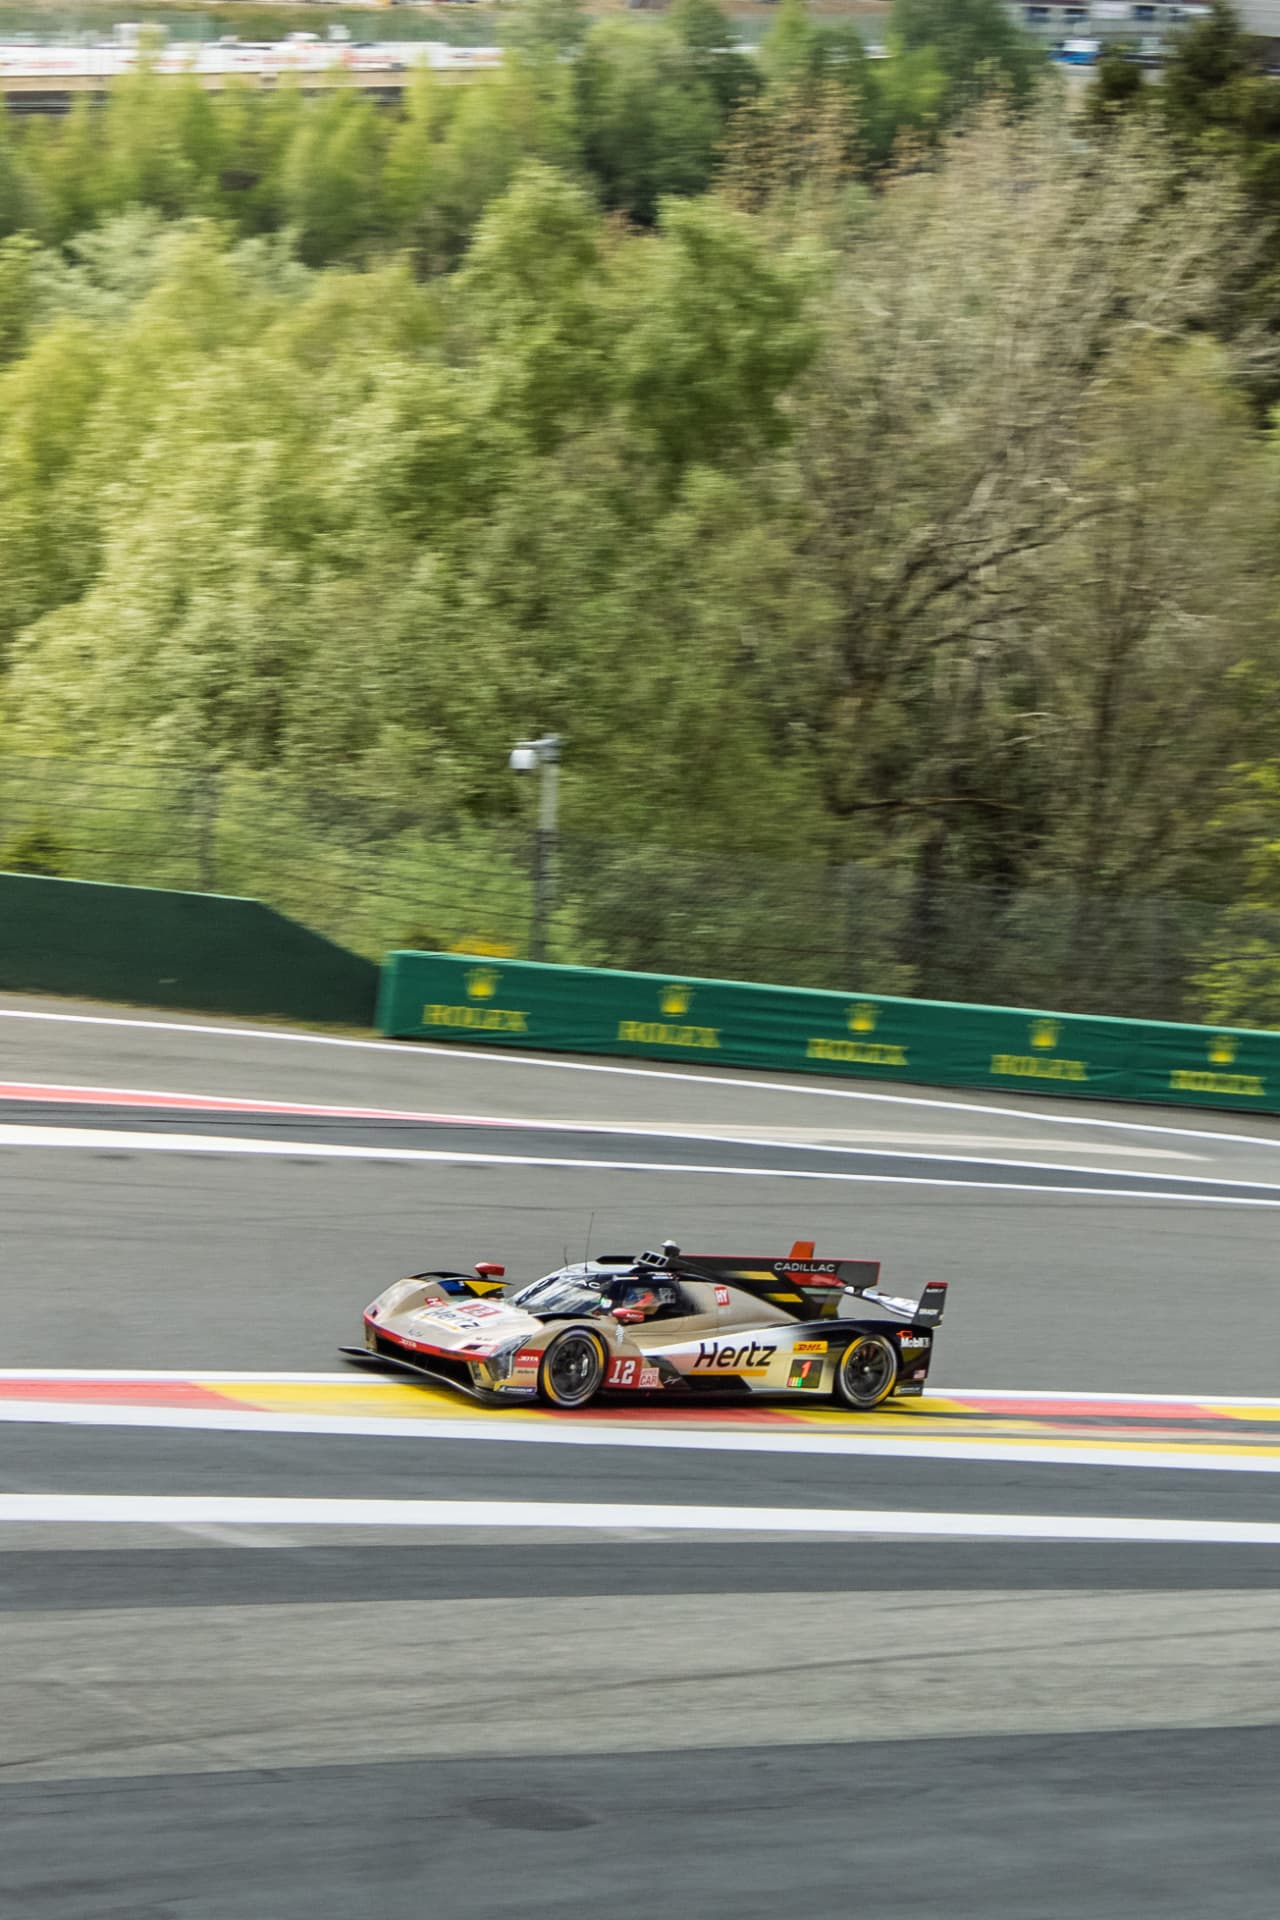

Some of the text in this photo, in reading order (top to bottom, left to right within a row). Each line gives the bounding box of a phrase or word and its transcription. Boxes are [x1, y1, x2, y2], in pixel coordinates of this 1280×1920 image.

[422, 1004, 530, 1032] ROLEX
[617, 1020, 722, 1049] ROLEX
[806, 1038, 909, 1066] ROLEX
[990, 1054, 1089, 1081] ROLEX
[1169, 1070, 1266, 1096] ROLEX
[774, 1262, 835, 1272] CADILLAC
[693, 1341, 777, 1368] Hertz
[797, 1343, 823, 1351] DHL
[608, 1359, 636, 1384] 12
[640, 1375, 658, 1386] CAR
[801, 1360, 812, 1379] 1
